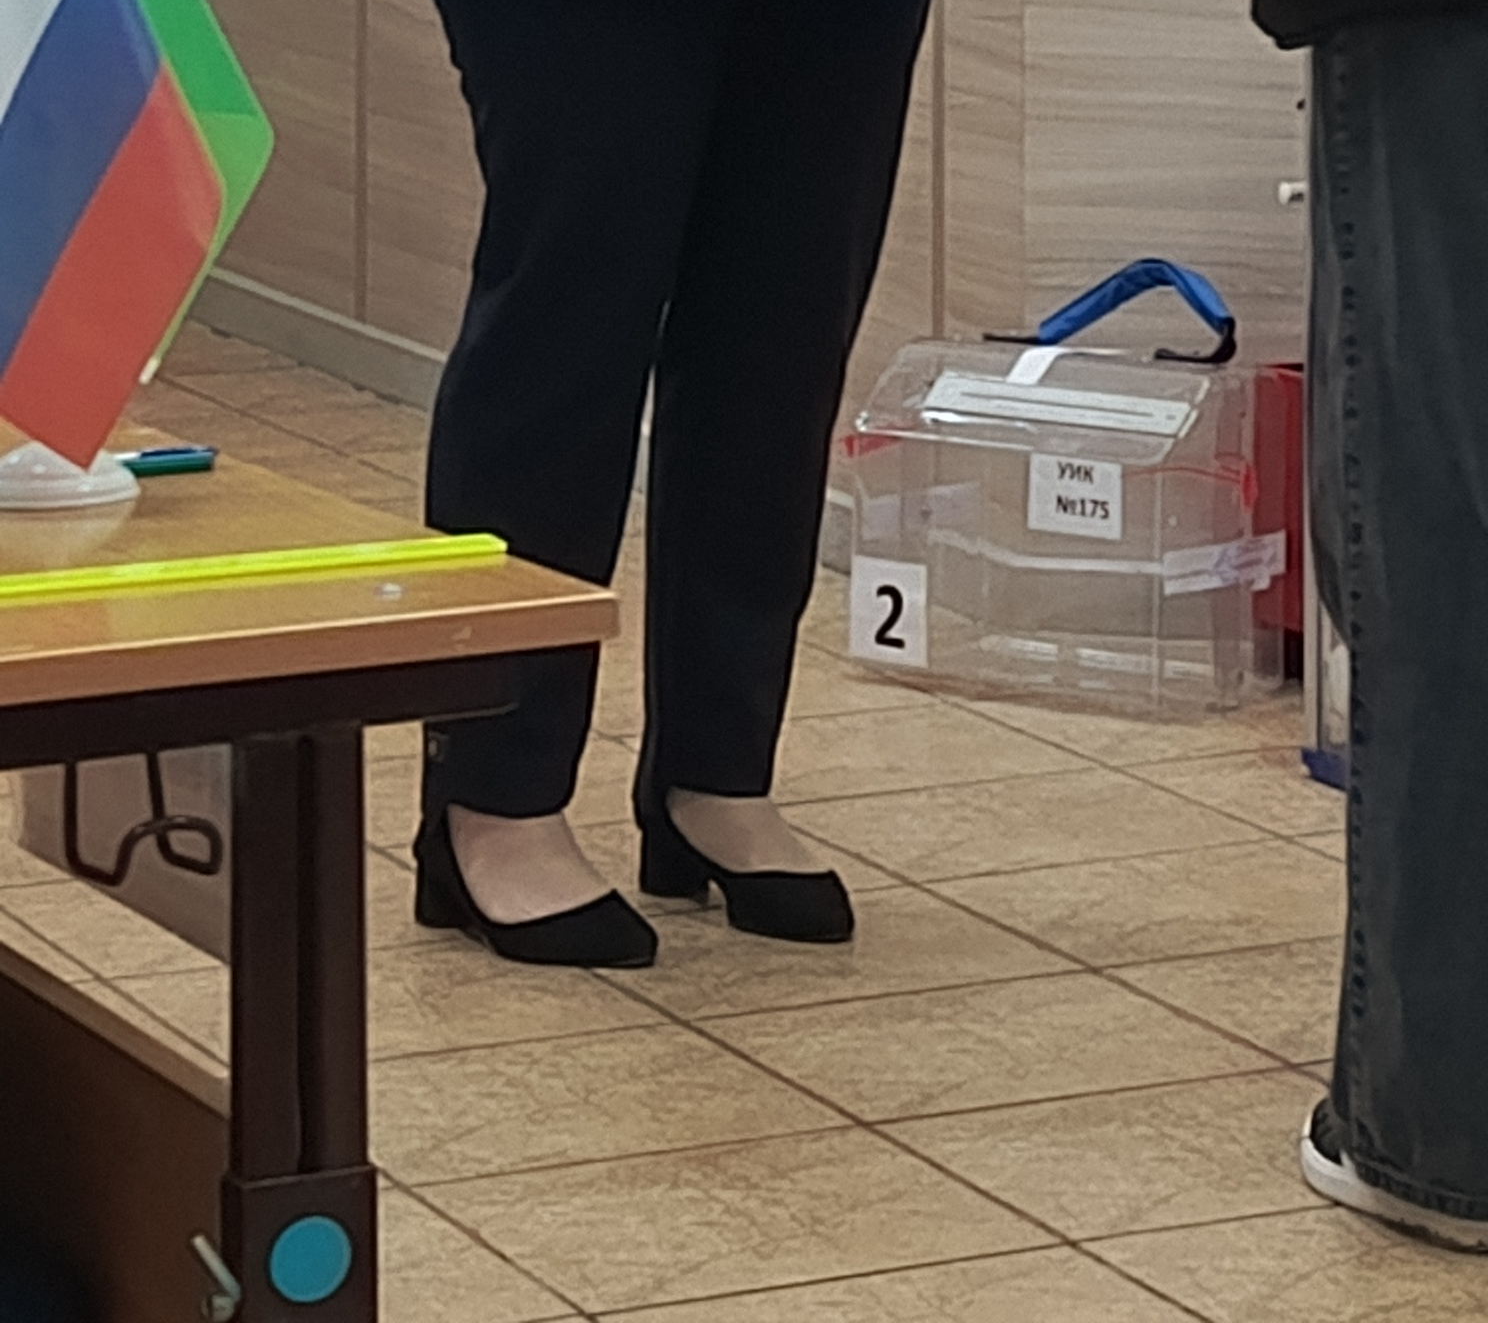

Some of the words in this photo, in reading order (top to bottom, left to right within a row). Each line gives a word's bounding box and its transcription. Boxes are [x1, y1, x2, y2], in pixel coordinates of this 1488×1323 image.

[1057, 460, 1094, 486] УИК
[1056, 495, 1110, 520] №175
[873, 584, 907, 650] 2
